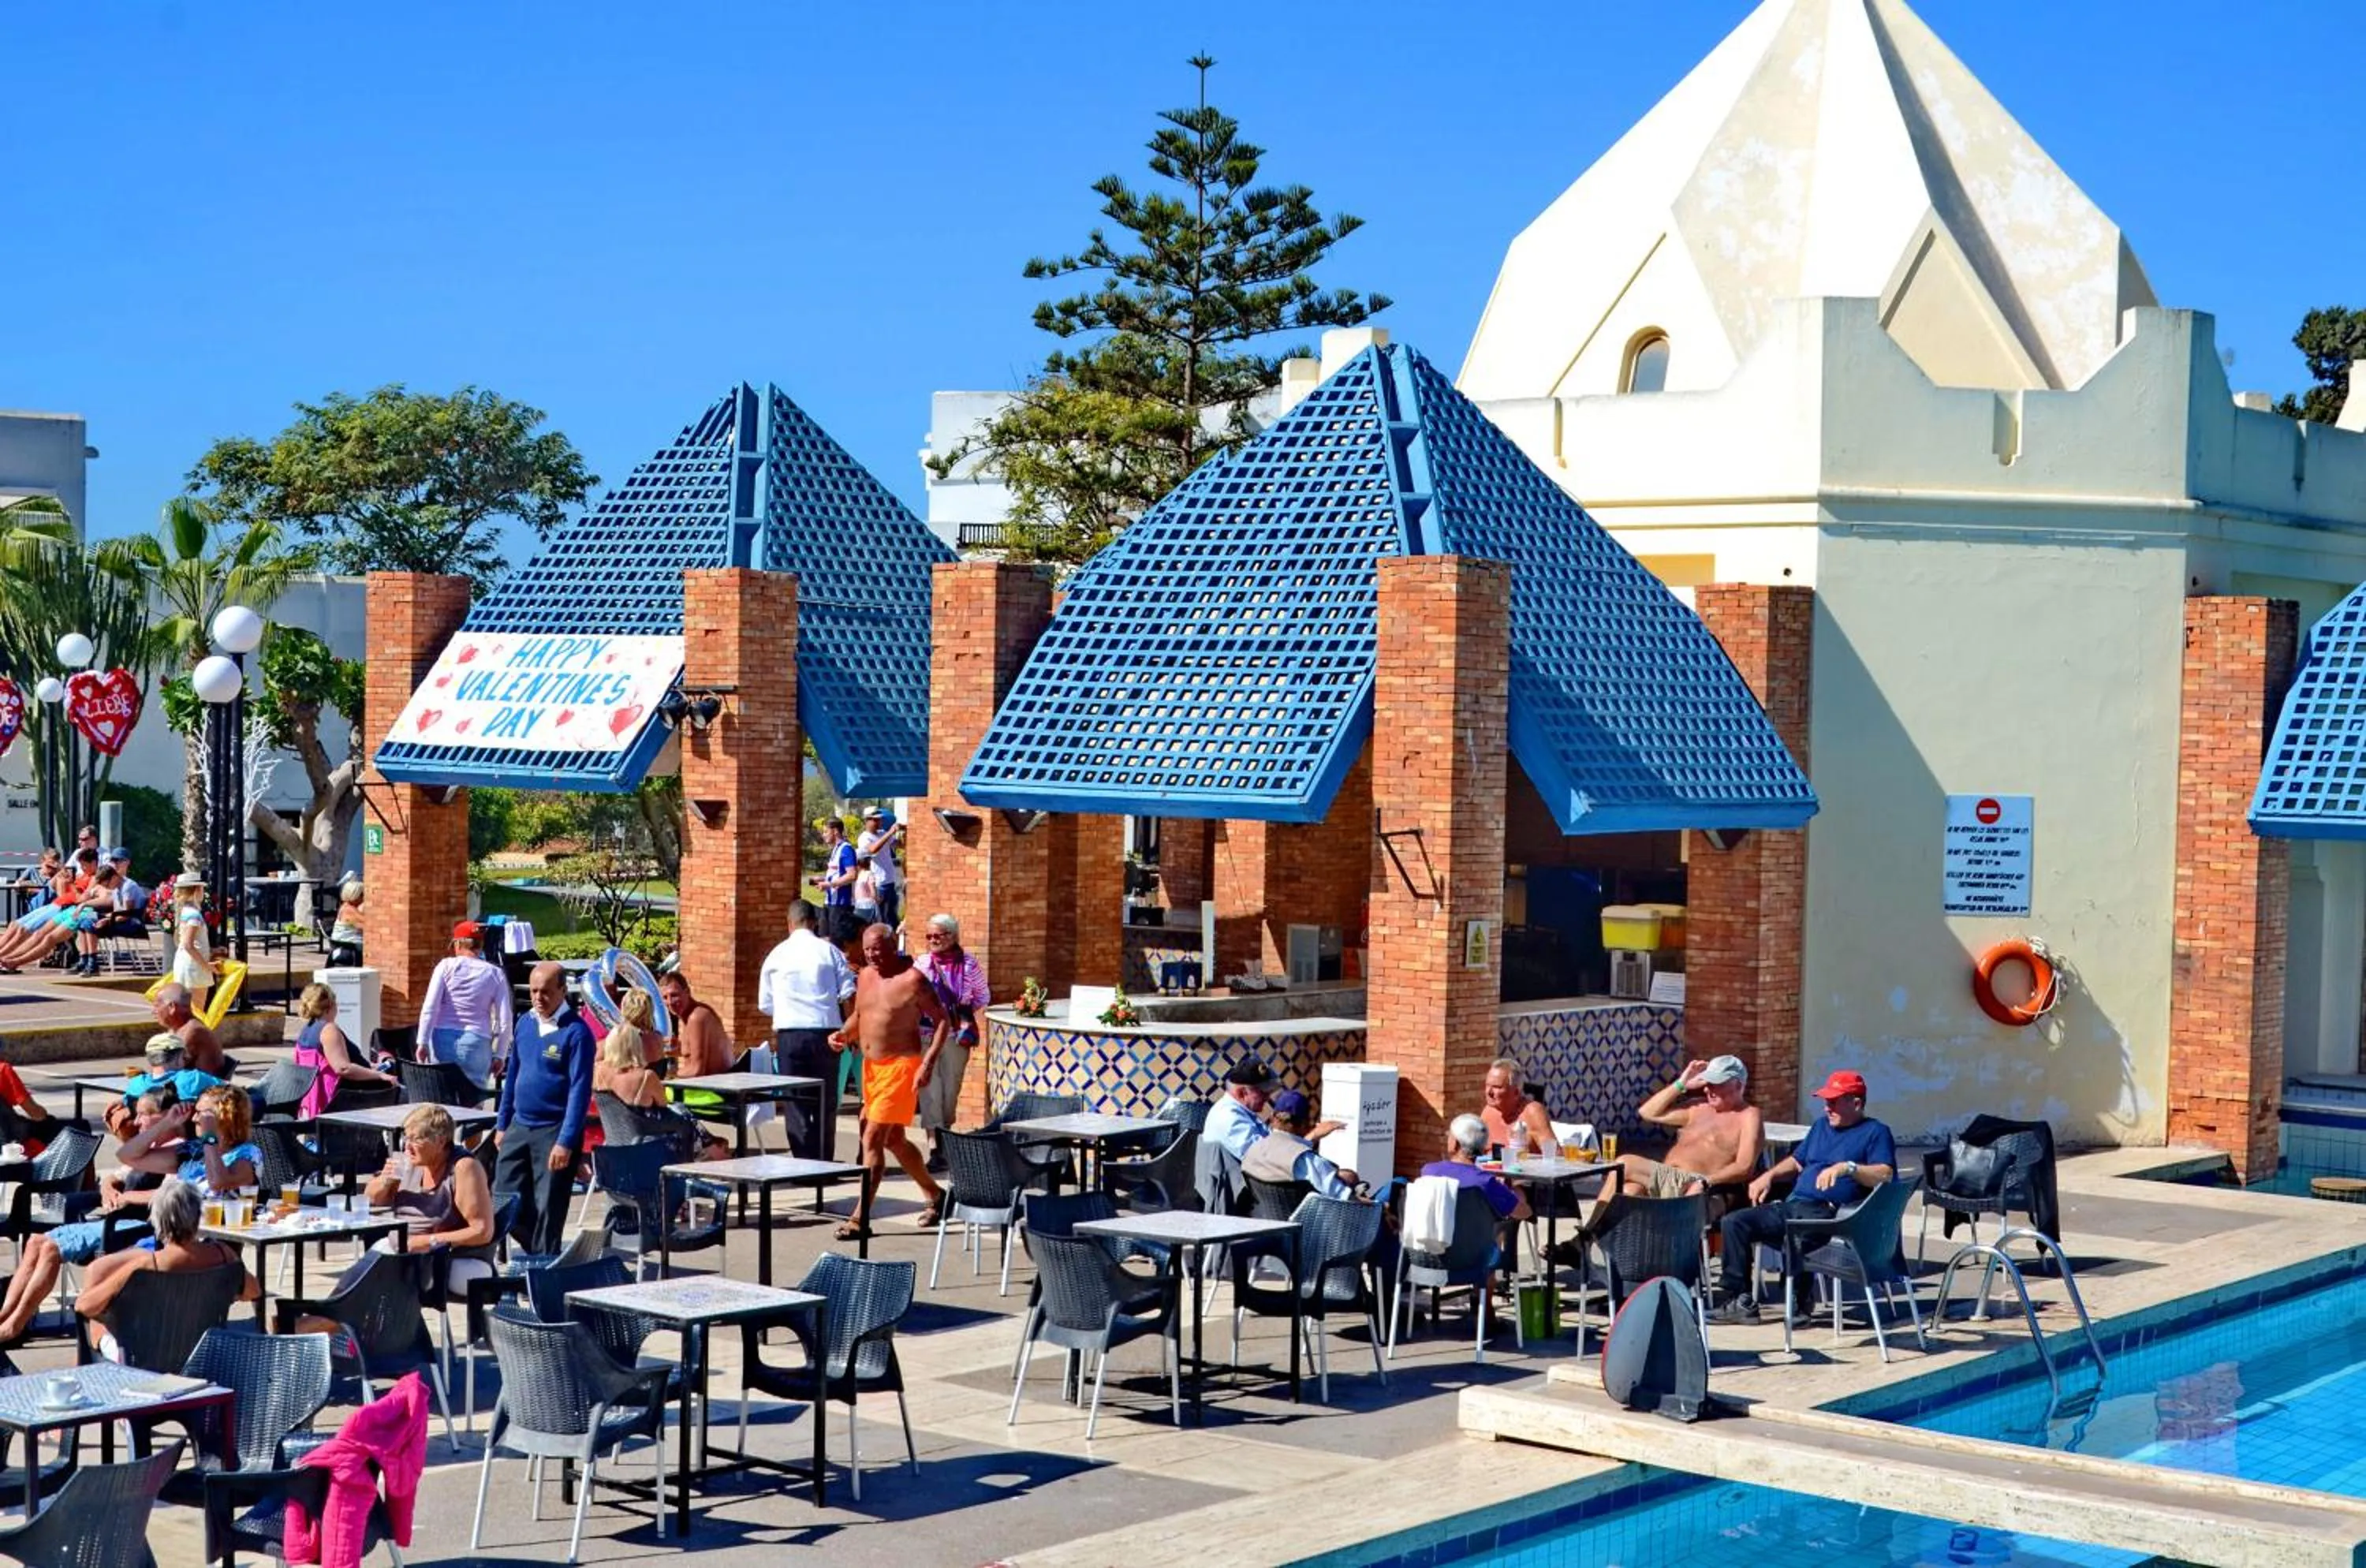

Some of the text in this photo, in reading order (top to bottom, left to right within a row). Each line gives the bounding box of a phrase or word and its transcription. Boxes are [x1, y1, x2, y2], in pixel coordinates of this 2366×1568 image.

[506, 637, 614, 670] HAPPY
[455, 670, 632, 706] VALENTINES
[84, 693, 131, 719] LIEBE
[480, 706, 547, 739] DAY
